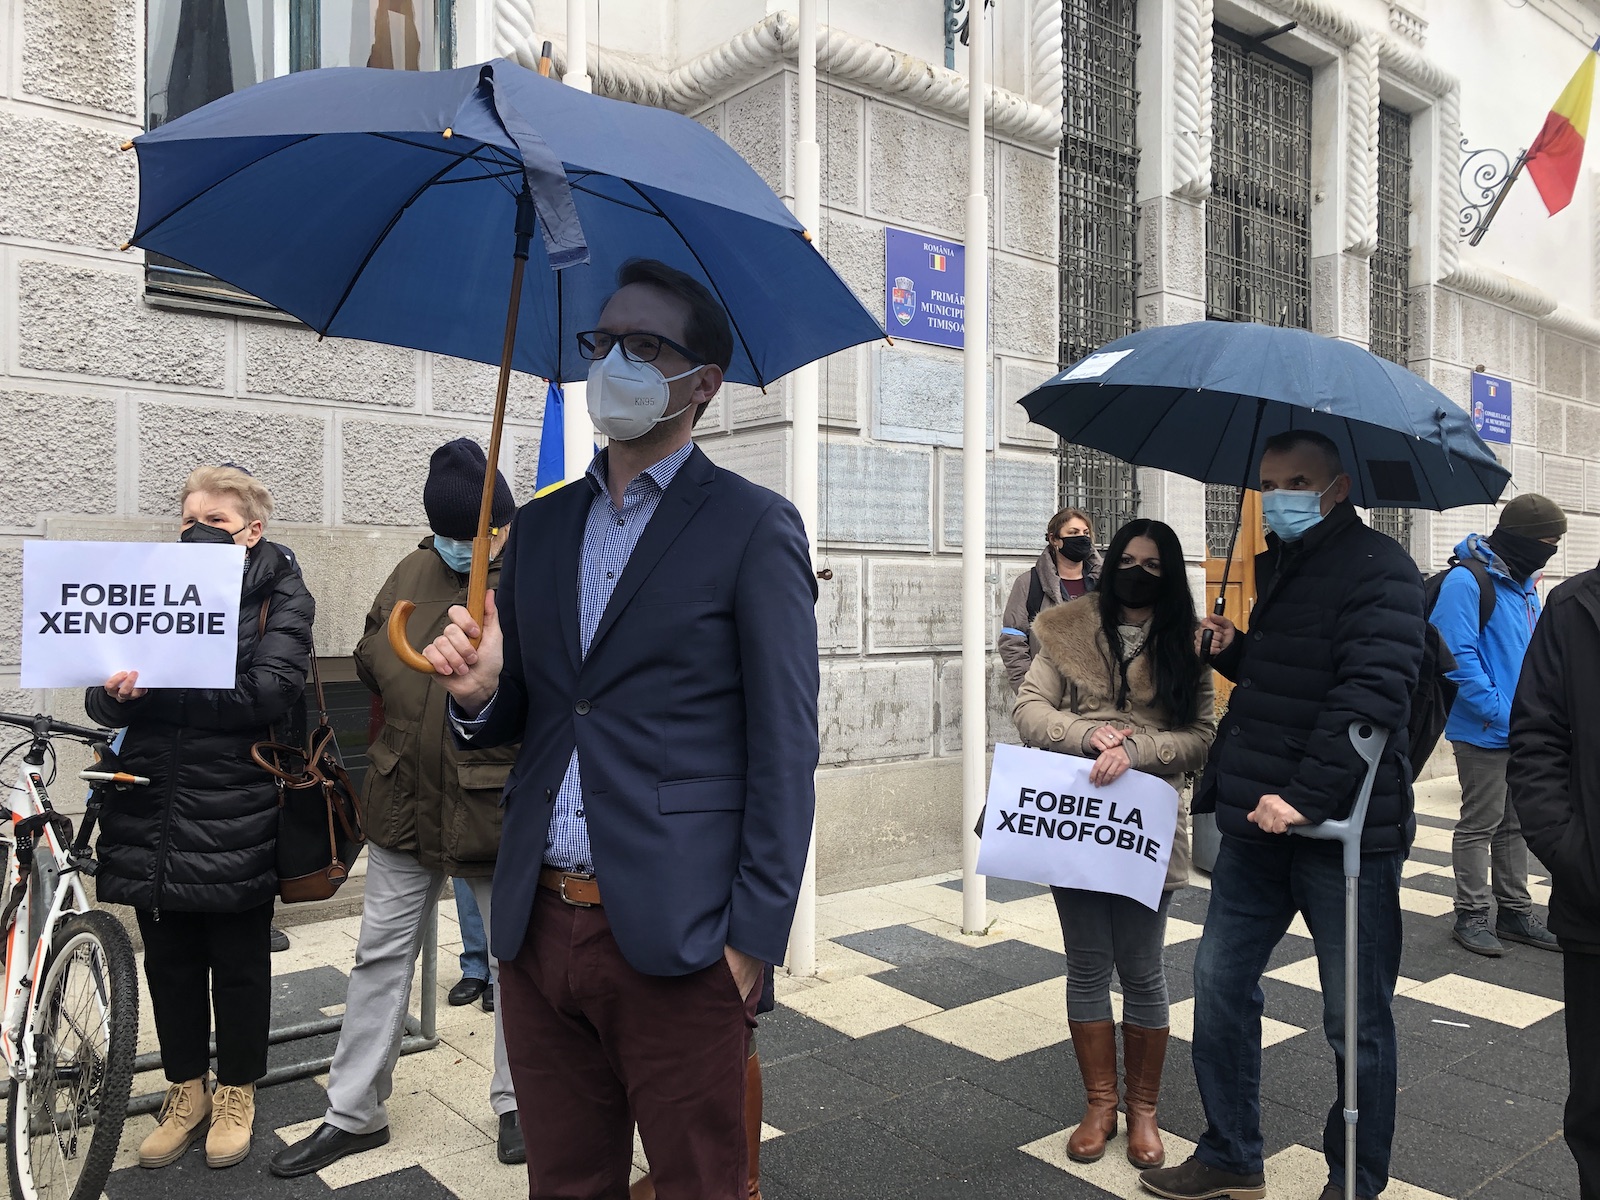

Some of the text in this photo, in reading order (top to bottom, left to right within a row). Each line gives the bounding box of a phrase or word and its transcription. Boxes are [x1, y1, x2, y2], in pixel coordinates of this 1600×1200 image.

[923, 243, 954, 256] ROMÂNIA
[921, 302, 965, 319] MUNICIPI
[634, 397, 655, 405] KN95
[61, 583, 202, 607] FOBIE LA
[38, 611, 226, 635] XENOFOBIE
[1018, 786, 1144, 831] FOBIE LA
[996, 809, 1161, 863] XENOFOBIE
